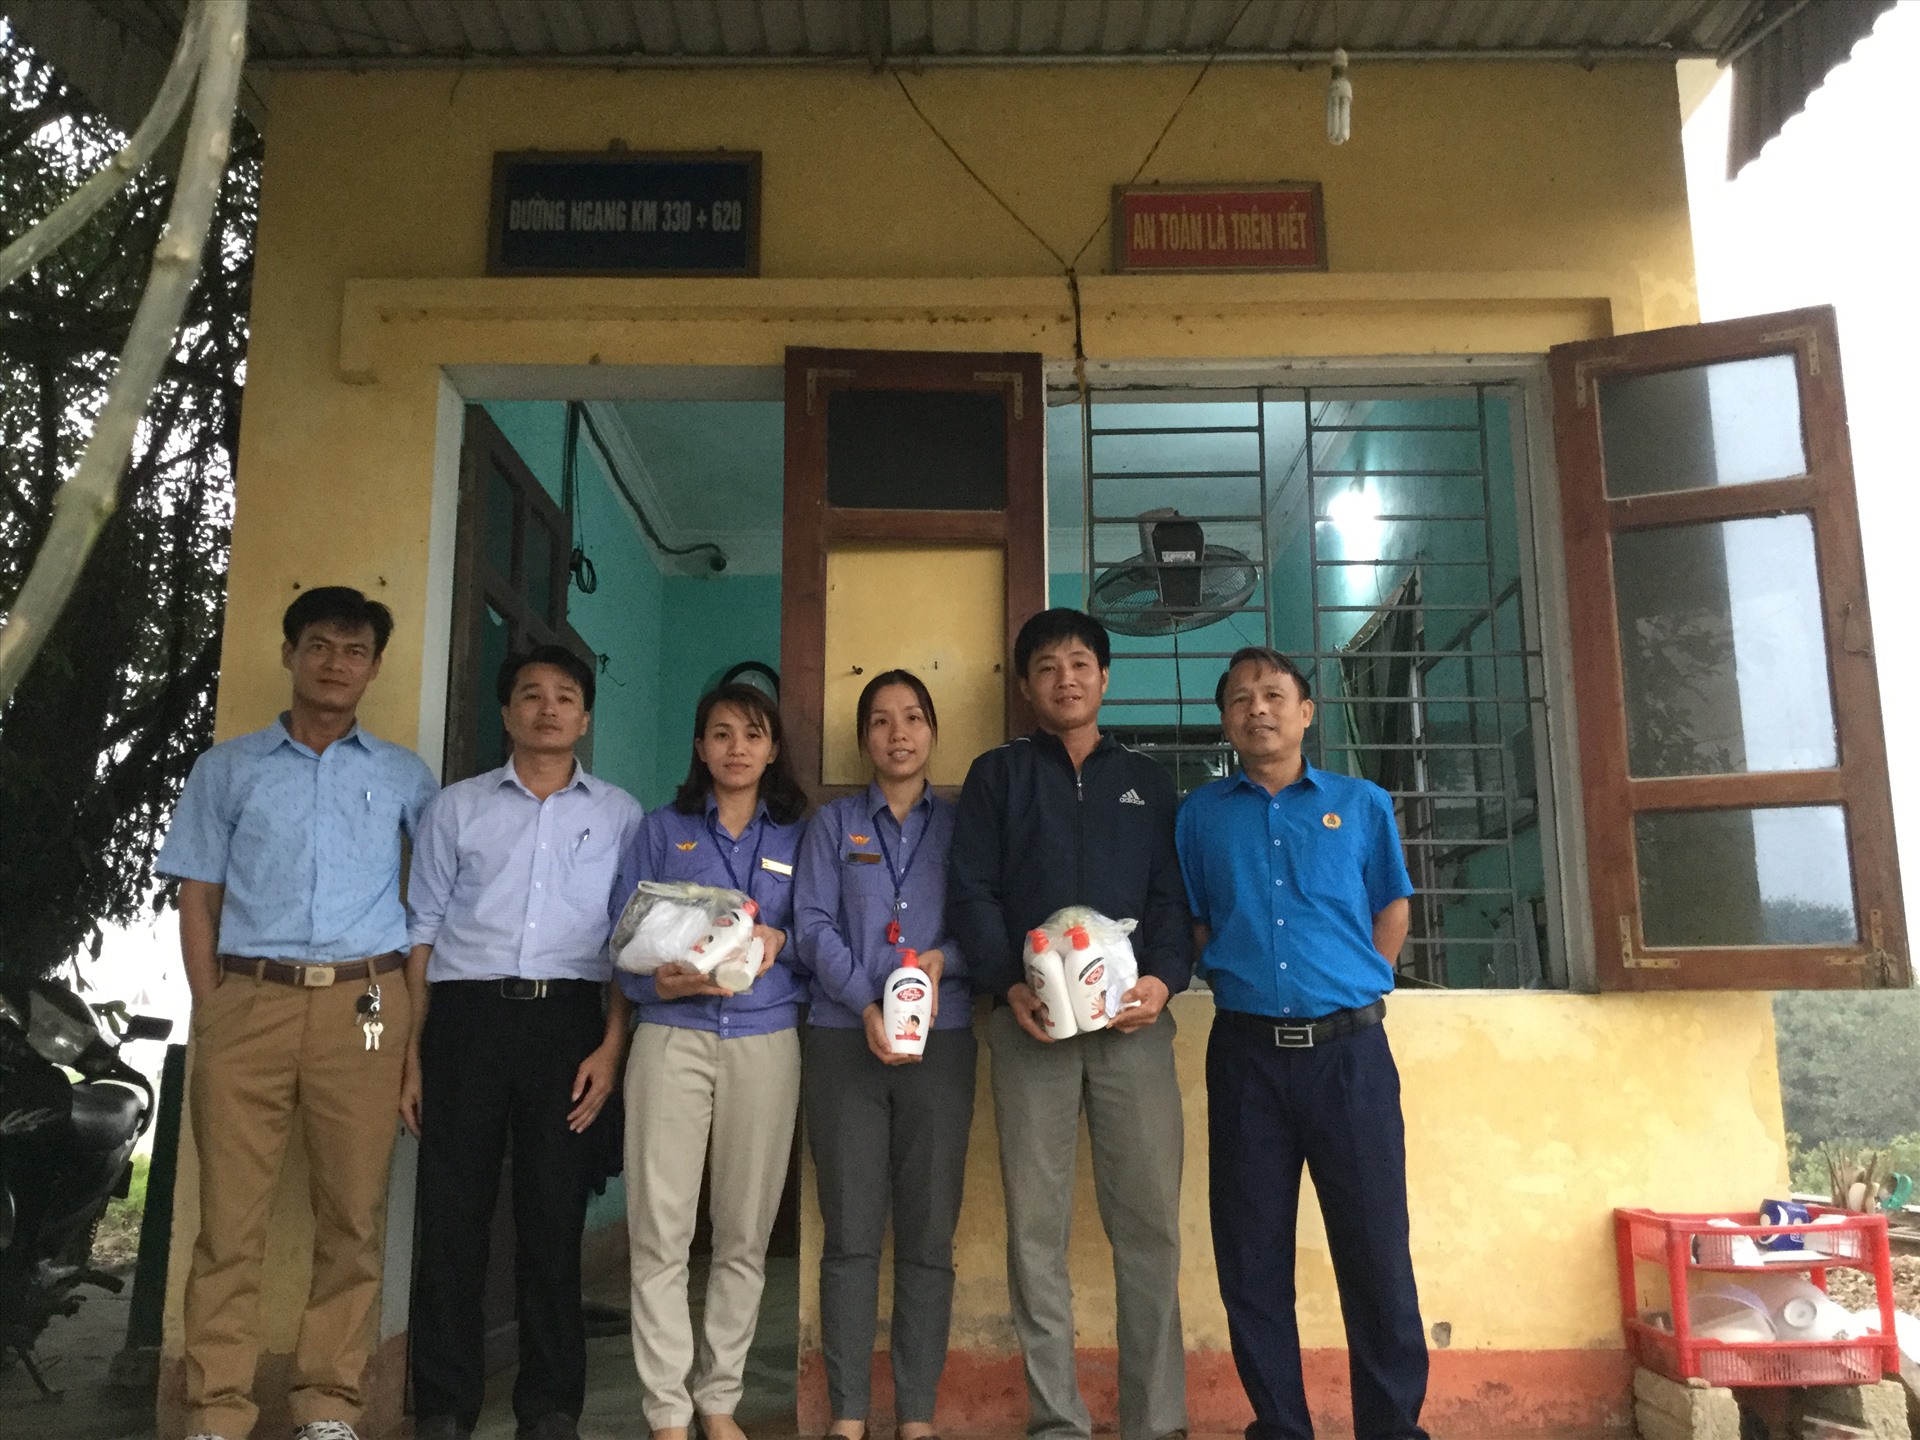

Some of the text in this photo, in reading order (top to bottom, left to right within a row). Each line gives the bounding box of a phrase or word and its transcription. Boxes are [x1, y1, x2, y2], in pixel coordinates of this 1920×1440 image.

[569, 200, 627, 232] NGANG
[630, 200, 658, 232] KM
[661, 200, 692, 232] 330
[696, 208, 708, 229] +
[711, 200, 742, 232] 620
[1133, 199, 1307, 250] AN TOÀN LÀ TRÊN HẾT
[1119, 797, 1146, 806] adidas
